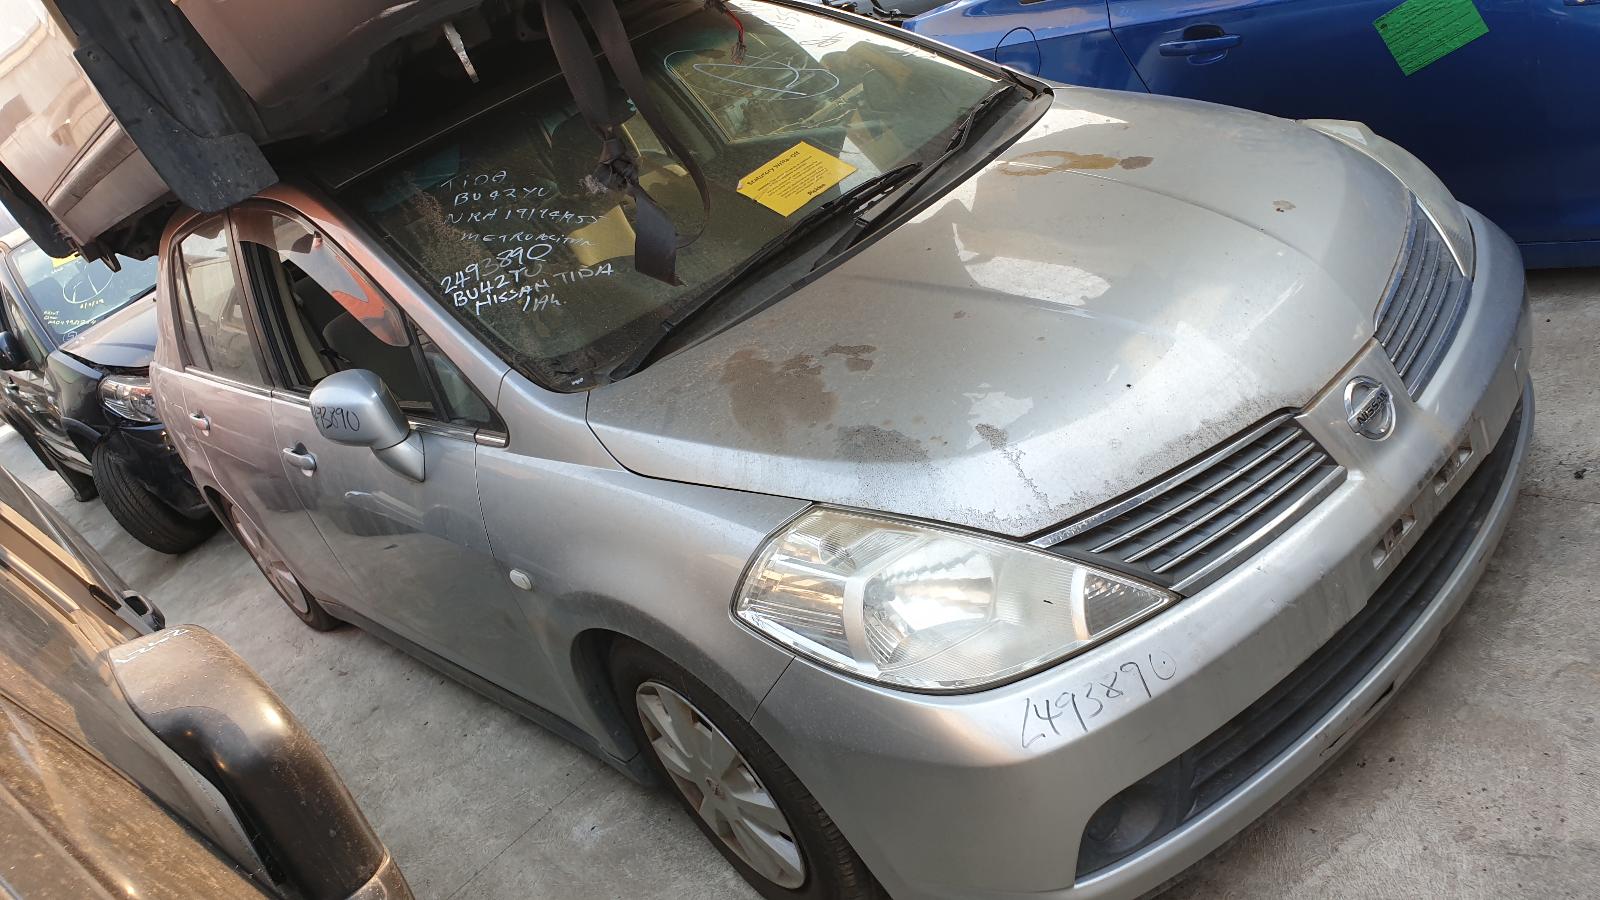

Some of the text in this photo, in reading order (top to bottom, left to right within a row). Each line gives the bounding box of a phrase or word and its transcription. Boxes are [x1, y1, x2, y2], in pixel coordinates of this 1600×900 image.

[440, 243, 553, 294] 2493890
[475, 262, 614, 316] NISSAN TIDA
[1356, 390, 1388, 424] NISSAN
